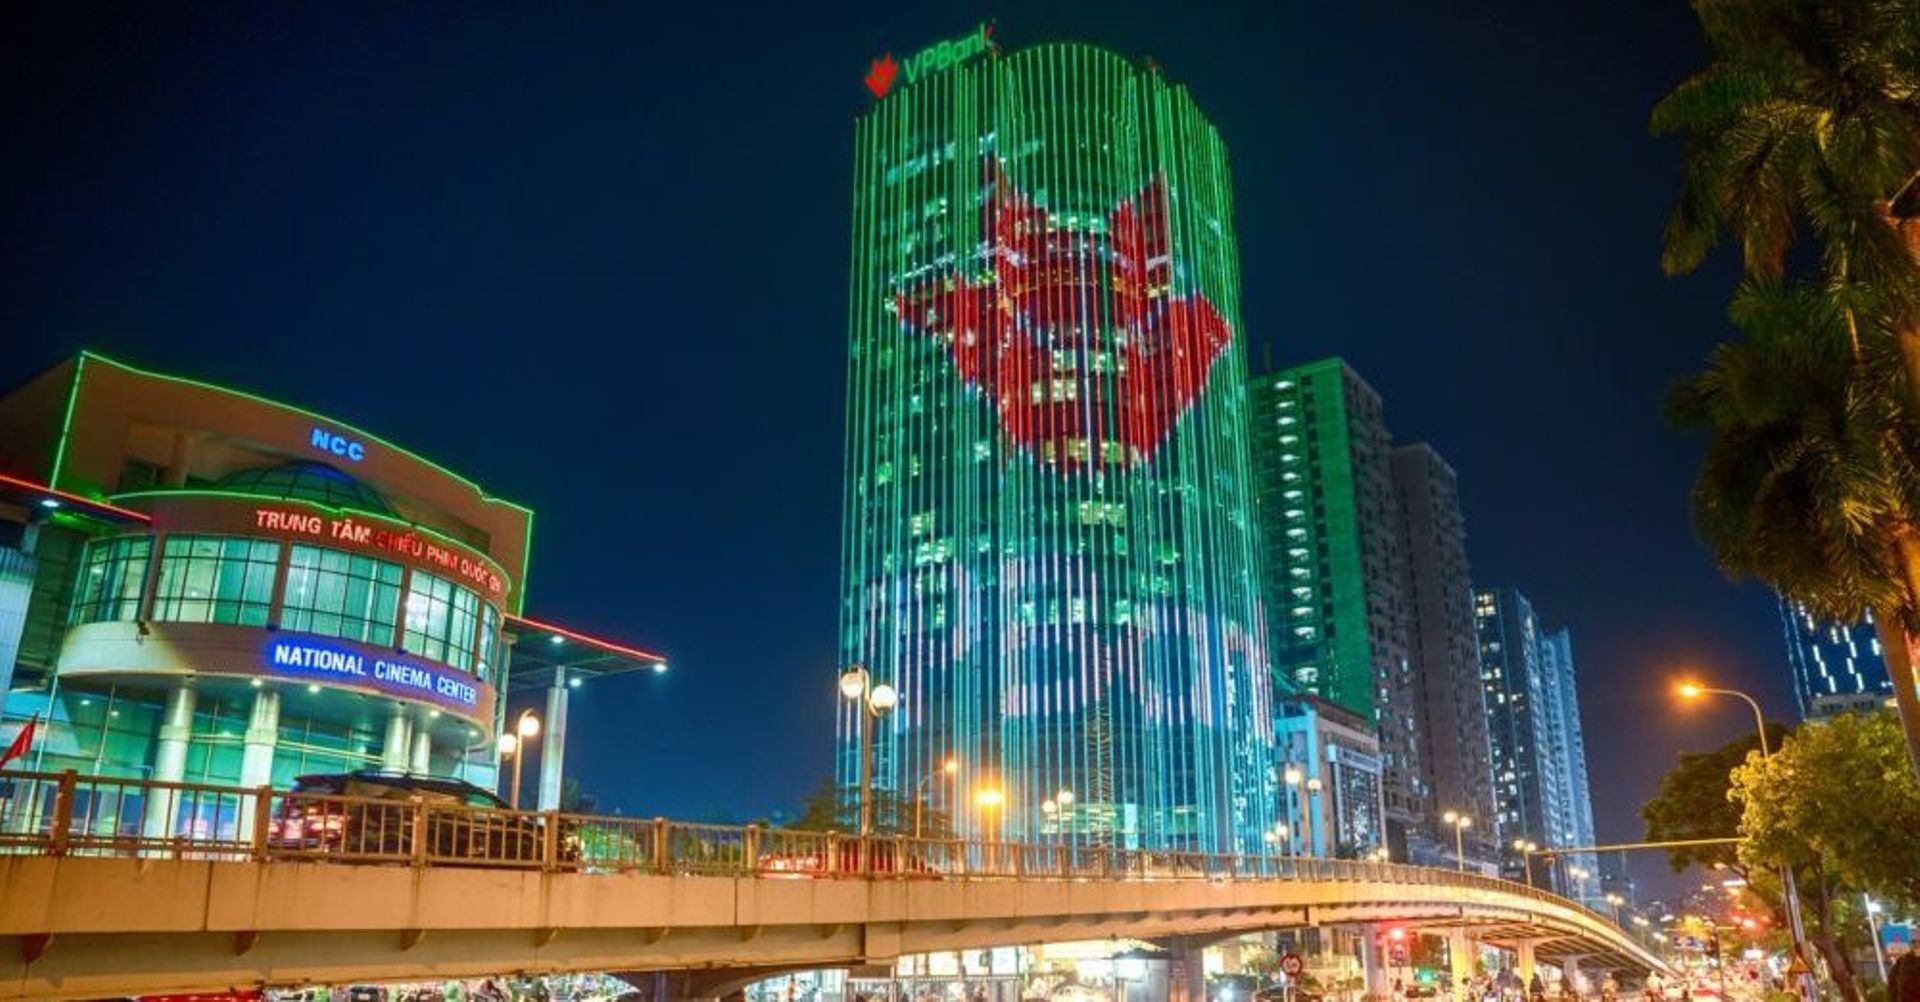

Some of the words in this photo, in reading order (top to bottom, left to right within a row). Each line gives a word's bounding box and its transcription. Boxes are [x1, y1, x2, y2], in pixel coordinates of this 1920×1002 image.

[903, 22, 994, 83] VPBank
[311, 428, 364, 460] NCC
[256, 510, 322, 534] TRUNG
[331, 519, 371, 543] TÂM
[275, 645, 367, 676] NATIONAL
[374, 661, 431, 690] CINEMA
[437, 676, 476, 705] CENTER
